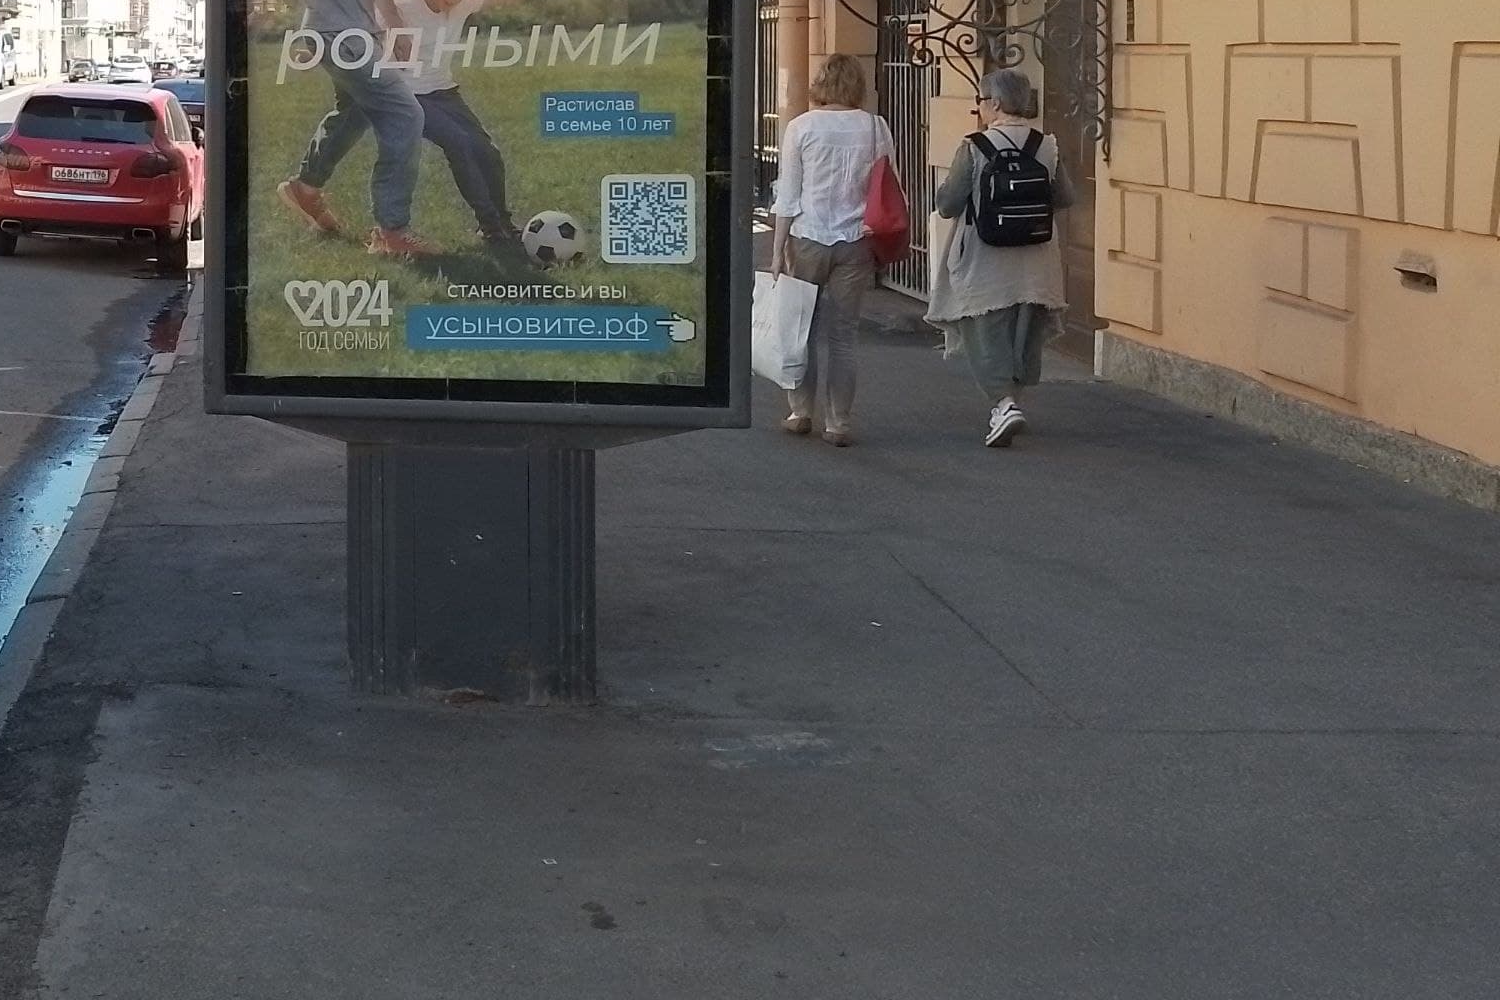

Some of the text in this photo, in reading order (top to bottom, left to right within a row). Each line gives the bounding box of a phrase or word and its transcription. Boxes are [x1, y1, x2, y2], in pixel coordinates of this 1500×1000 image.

[275, 22, 661, 85] родными
[546, 97, 635, 111] Растислав
[546, 116, 671, 131] в семье 10 лет
[447, 284, 627, 299] СТАНОВИТЕСЬ И ВЫ
[299, 280, 393, 328] 2024
[426, 311, 649, 341] усыновите.рф
